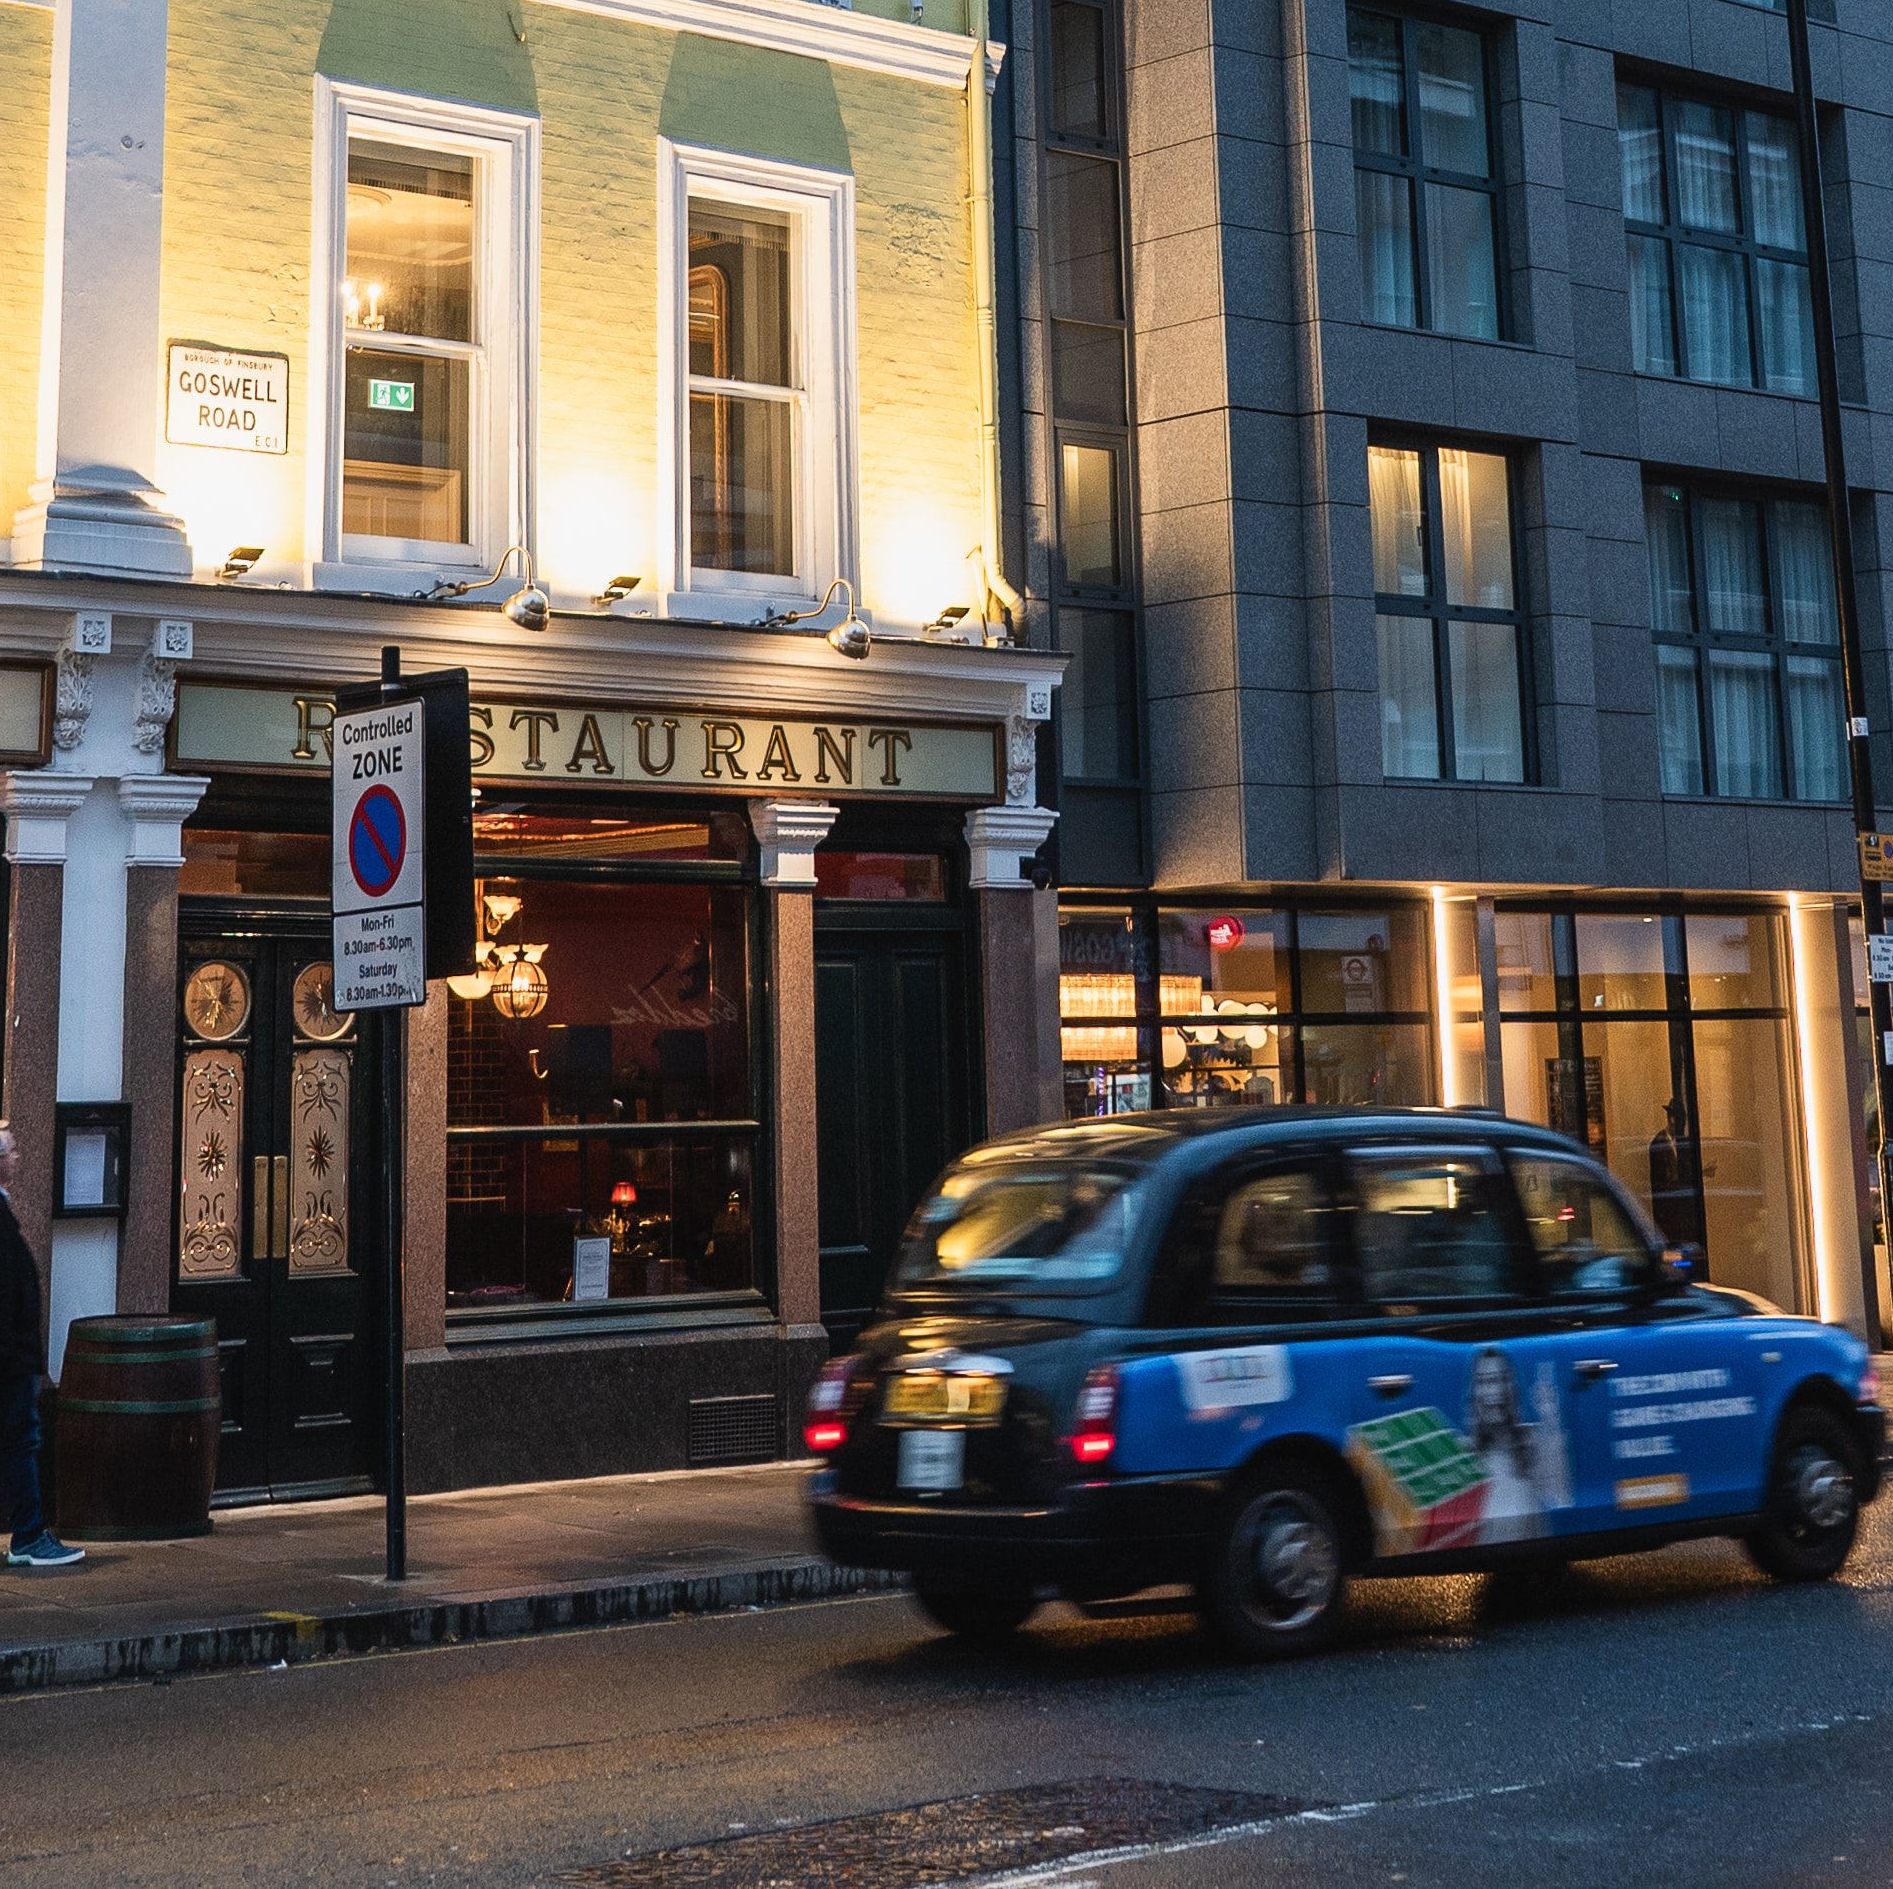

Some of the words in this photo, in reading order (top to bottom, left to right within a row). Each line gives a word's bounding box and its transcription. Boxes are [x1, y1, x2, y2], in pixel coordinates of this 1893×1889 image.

[184, 354, 220, 364] BOROUGH
[224, 358, 233, 366] OF
[237, 360, 273, 371] FINSBURY
[179, 370, 277, 403] GOSWELL
[198, 405, 256, 431] ROAD
[291, 695, 913, 788] RSTAURANT
[342, 711, 413, 746] Controlled
[352, 745, 404, 780] ZONE
[361, 914, 395, 933] Mon-Fri
[344, 935, 413, 956] 8.30am-6.30pm
[358, 961, 398, 979] Saturday
